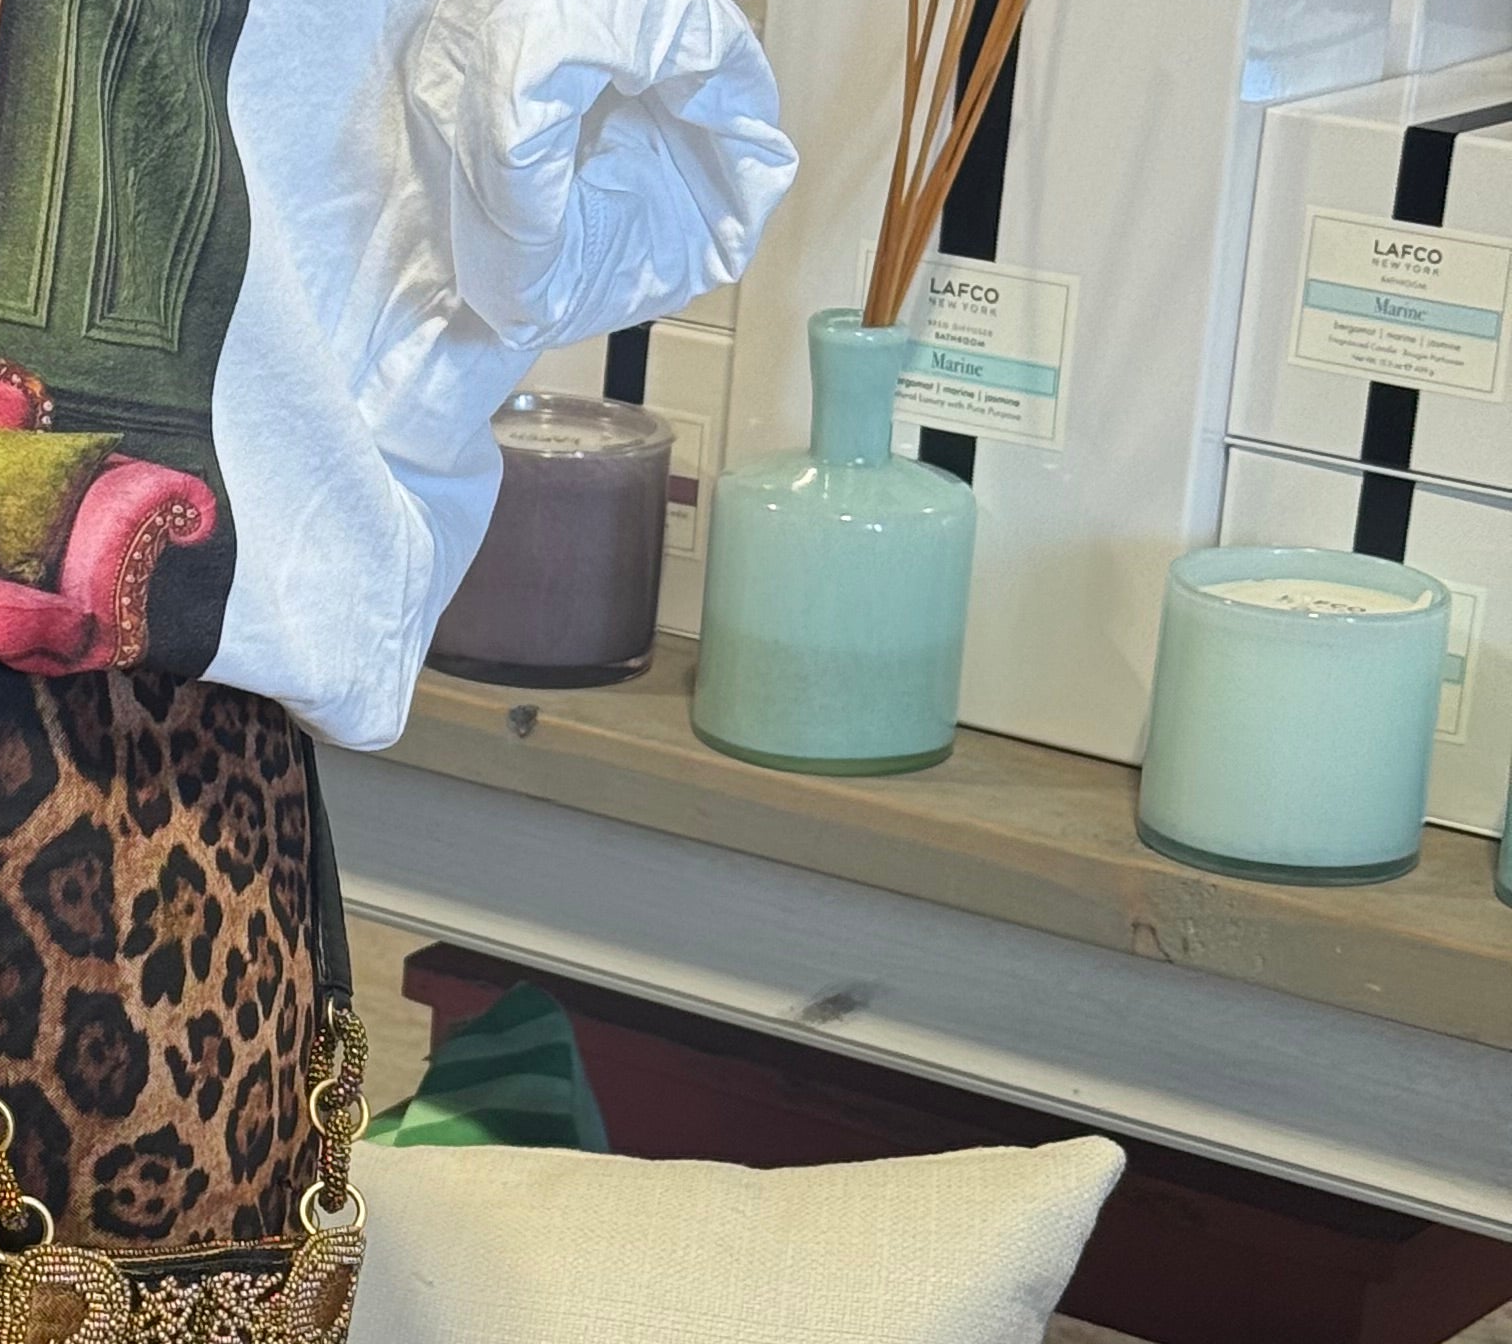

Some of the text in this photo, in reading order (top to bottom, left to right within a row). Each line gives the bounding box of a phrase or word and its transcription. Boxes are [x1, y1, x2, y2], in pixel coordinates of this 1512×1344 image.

[1373, 238, 1443, 265] LAFCO
[1371, 257, 1441, 277] NEW YORK
[929, 277, 1000, 305] LAFCO
[928, 297, 998, 318] NEW YORK
[1374, 296, 1428, 322] Marine
[934, 331, 986, 348] BATHROOM
[931, 351, 984, 378] Marine
[943, 385, 975, 399] marine
[984, 393, 1021, 408] jasmine
